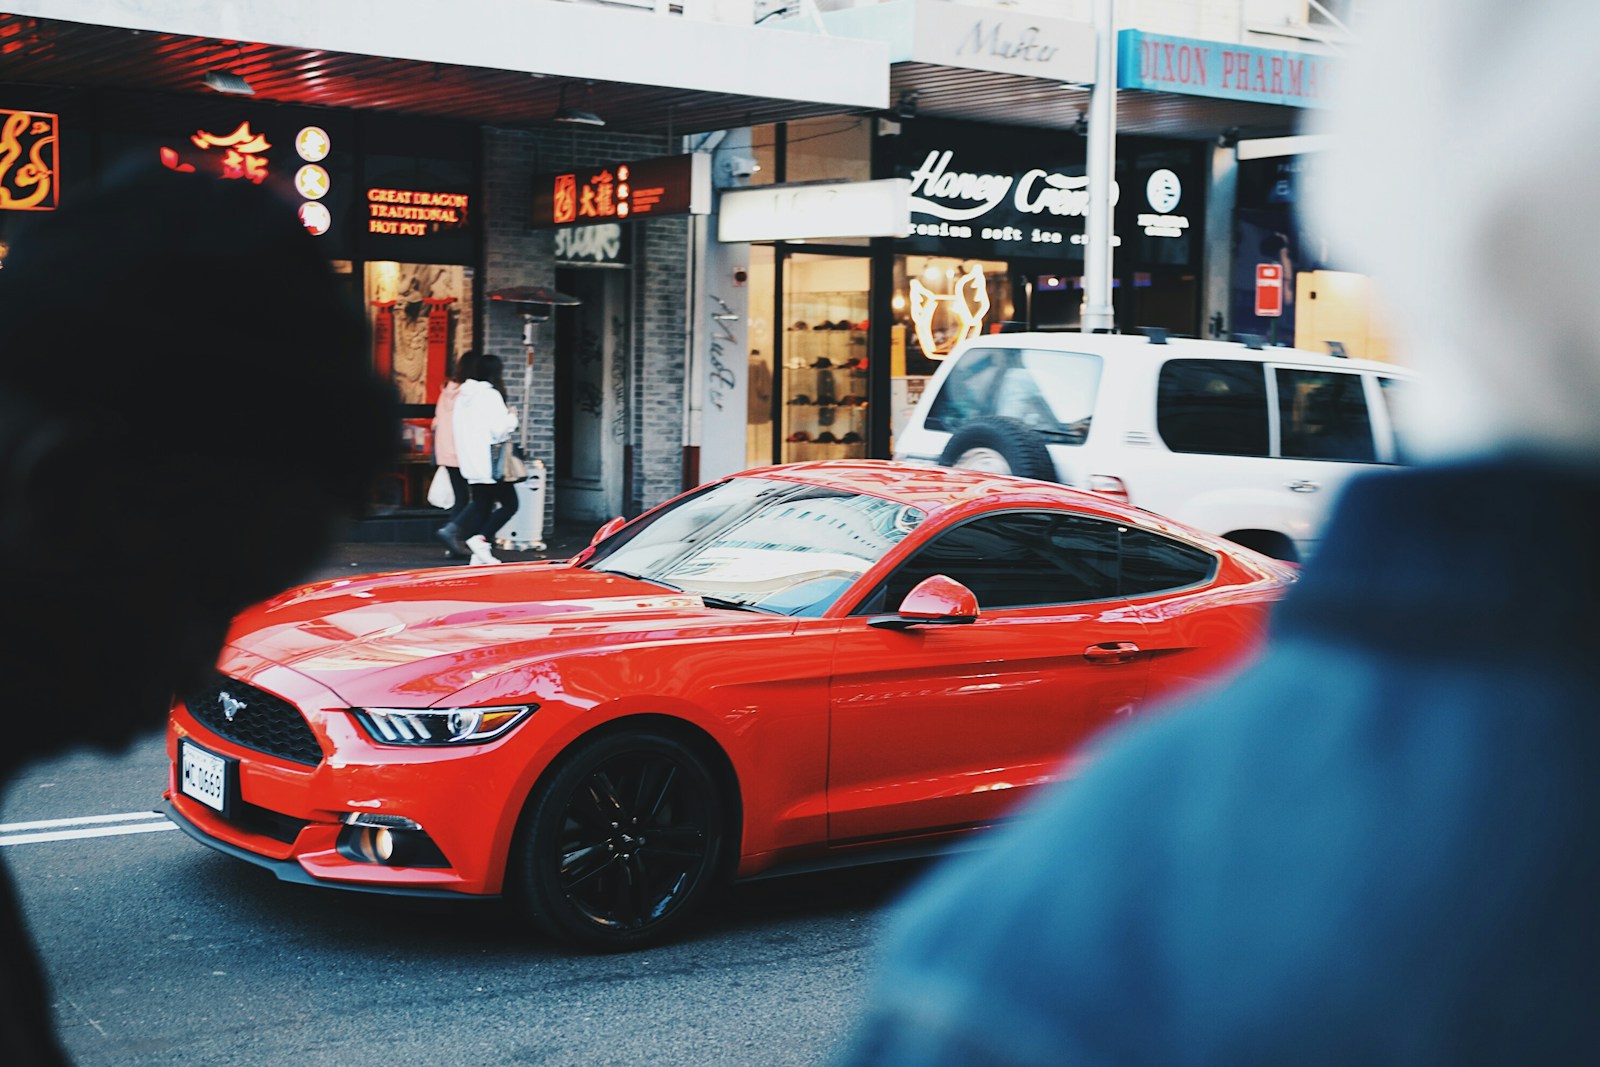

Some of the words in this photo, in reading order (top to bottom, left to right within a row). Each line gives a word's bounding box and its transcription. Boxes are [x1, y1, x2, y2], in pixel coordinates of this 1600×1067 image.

[1139, 40, 1208, 86] DIXON
[909, 150, 1013, 221] Honey
[1014, 168, 1119, 217] Crem
[367, 188, 412, 204] GREAT
[413, 192, 469, 207] DRAGON
[369, 204, 459, 223] TRADITIONAL
[369, 220, 398, 234] HOT
[399, 222, 428, 236] POT
[907, 222, 972, 238] remium
[981, 226, 1023, 241] soft
[1031, 229, 1062, 243] ice
